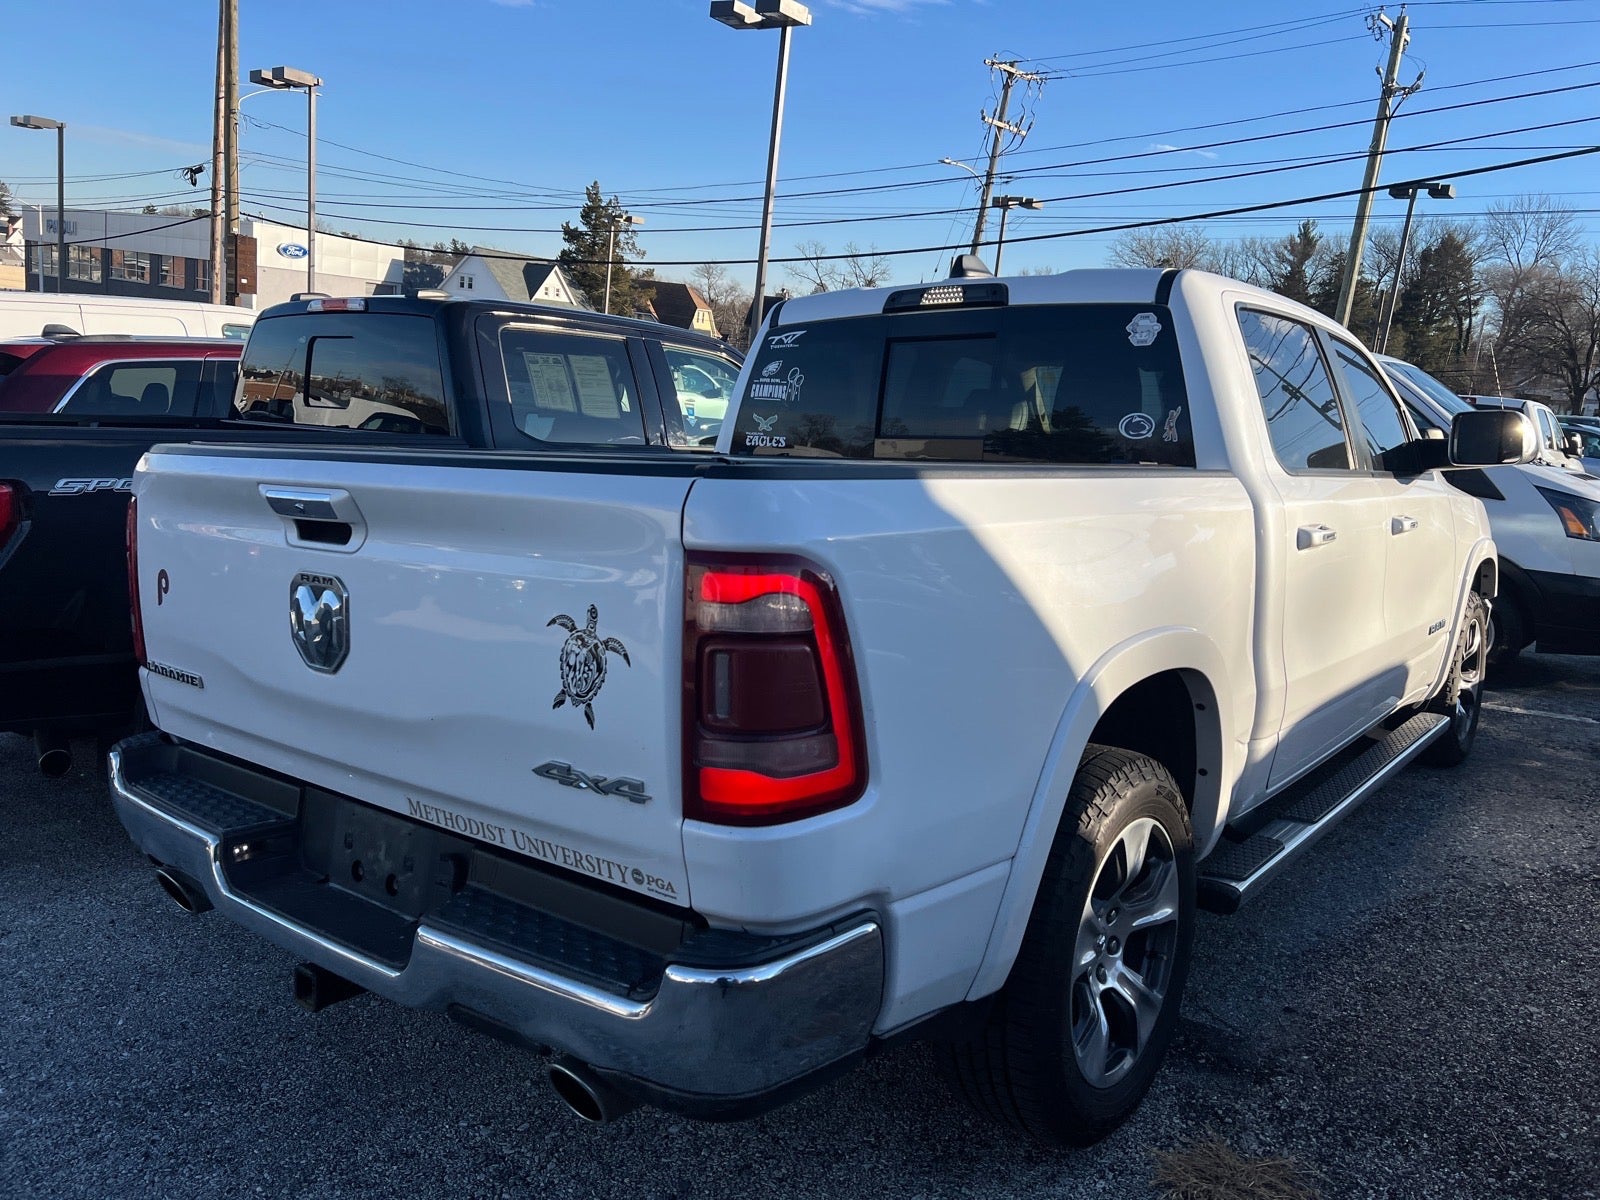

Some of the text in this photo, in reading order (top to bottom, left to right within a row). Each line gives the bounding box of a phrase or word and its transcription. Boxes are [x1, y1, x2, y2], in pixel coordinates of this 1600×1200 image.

[750, 384, 787, 400] CHAMPIONS
[745, 435, 786, 448] EAGLES
[300, 573, 333, 586] RAM
[147, 660, 199, 687] LARAMIE
[645, 873, 677, 895] PGA
